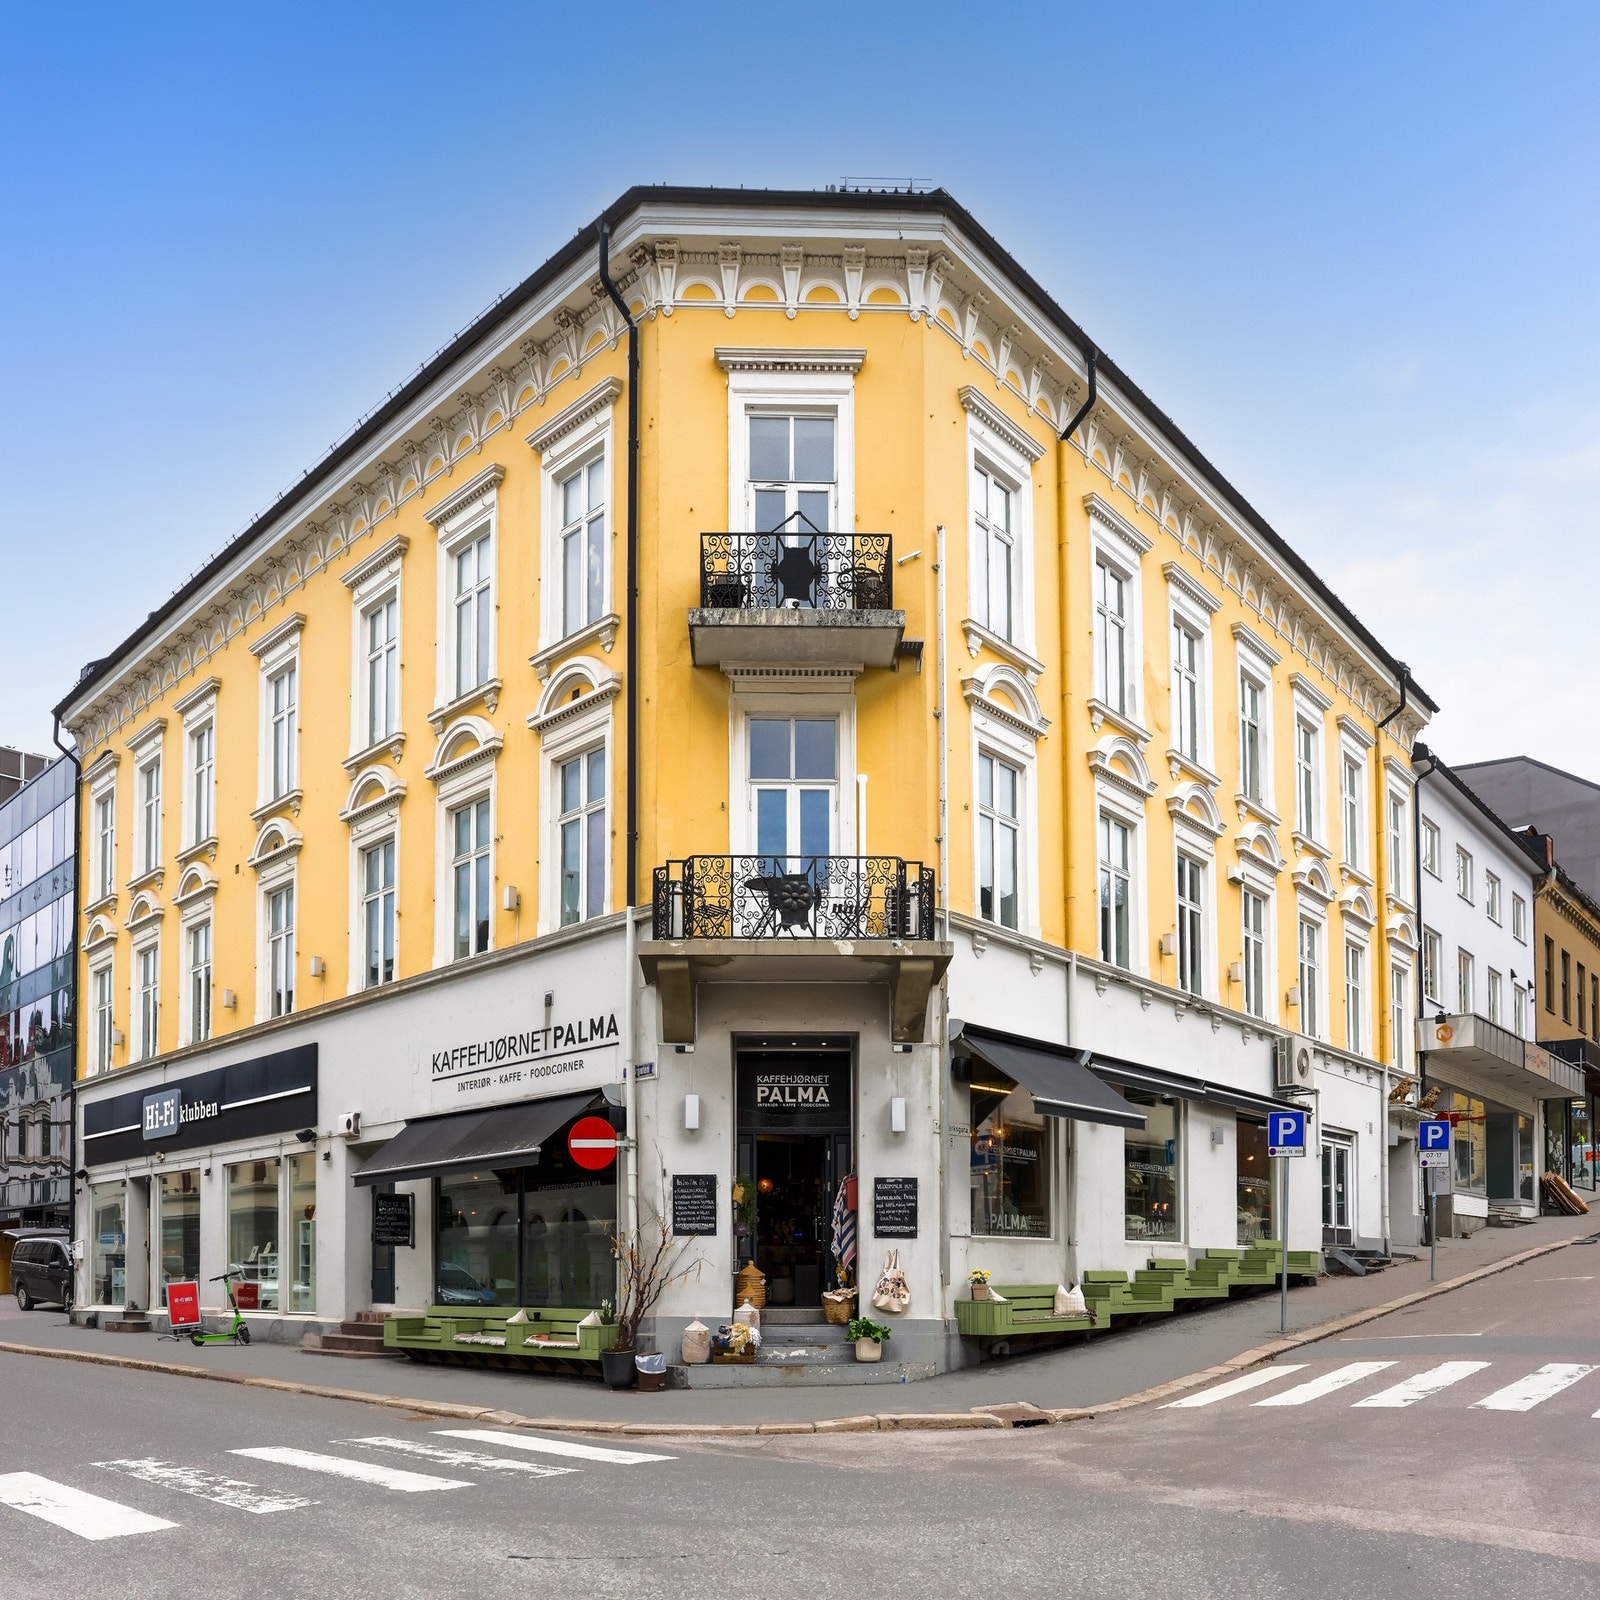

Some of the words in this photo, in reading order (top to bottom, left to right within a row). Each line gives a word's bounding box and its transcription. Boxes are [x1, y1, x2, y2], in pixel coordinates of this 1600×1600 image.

[457, 1077, 491, 1092] INTERIØR
[499, 1072, 522, 1085] KAFFE
[529, 1060, 585, 1079] FOODCORNER
[756, 1074, 830, 1084] KAFFEHJØRNET
[756, 1086, 830, 1103] PALMA
[145, 1098, 175, 1131] Hi-Fi
[179, 1100, 219, 1124] klubben
[1278, 1117, 1297, 1146] P
[1427, 1125, 1443, 1148] P
[989, 1213, 1028, 1230] PALMA
[1136, 1221, 1165, 1236] PALMA
